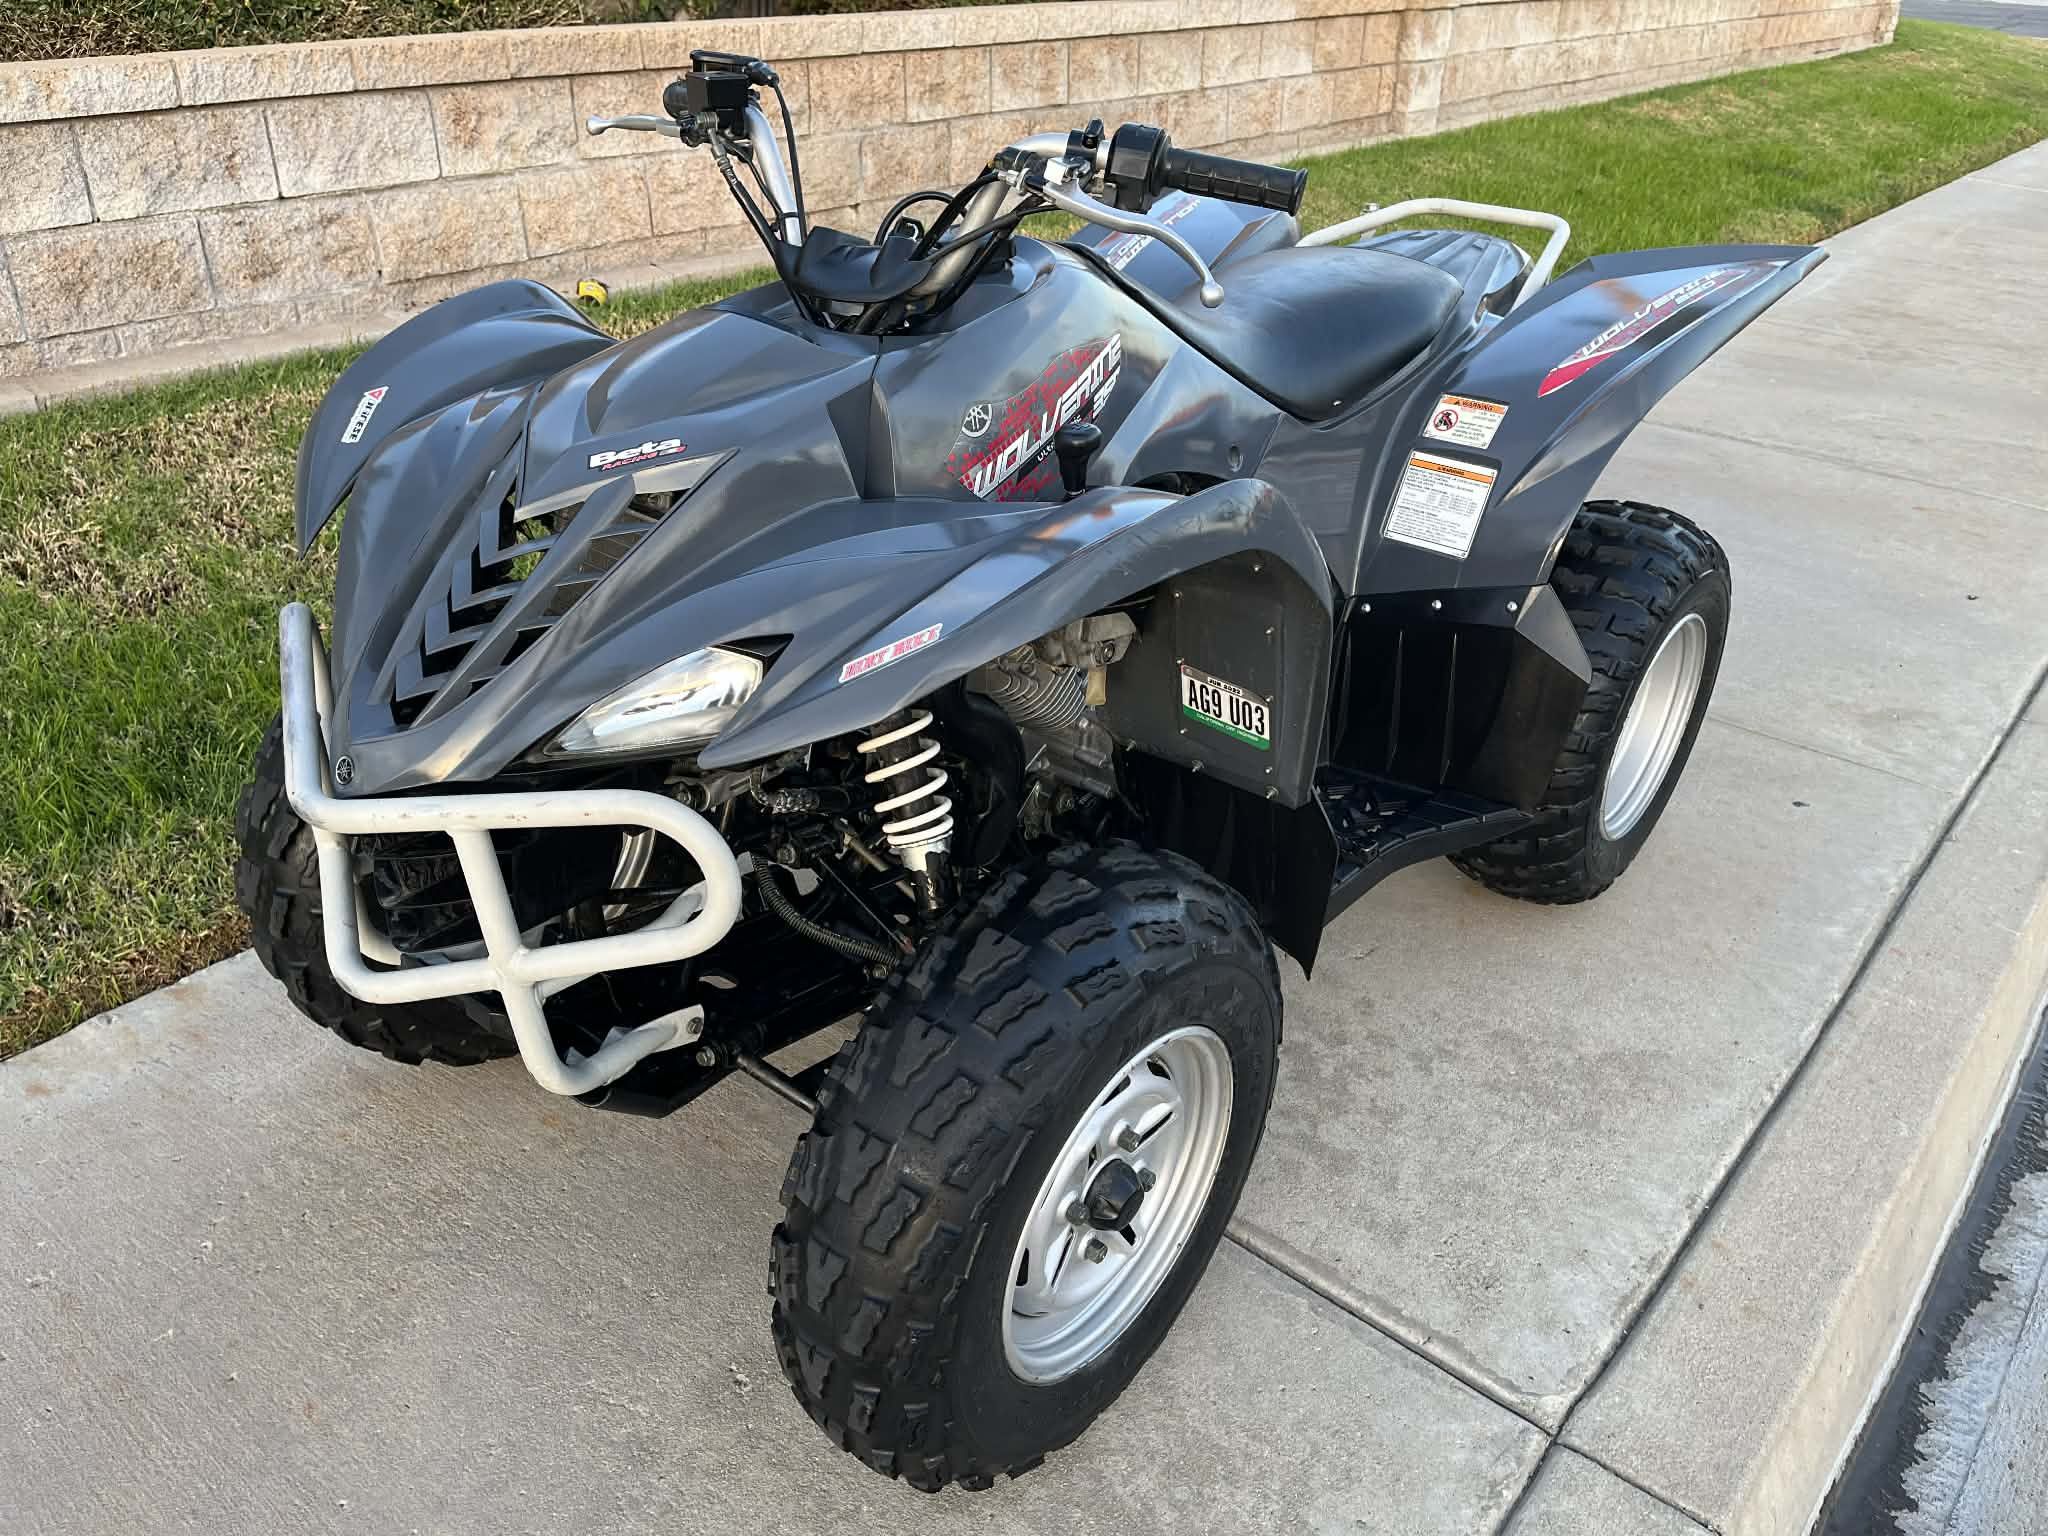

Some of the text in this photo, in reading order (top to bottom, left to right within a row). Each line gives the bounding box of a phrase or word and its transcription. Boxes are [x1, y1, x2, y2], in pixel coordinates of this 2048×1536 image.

[973, 332, 1121, 499] WOLVERINE
[1462, 399, 1494, 411] WARNING
[589, 438, 682, 469] Beta
[1188, 679, 1223, 719] AG9
